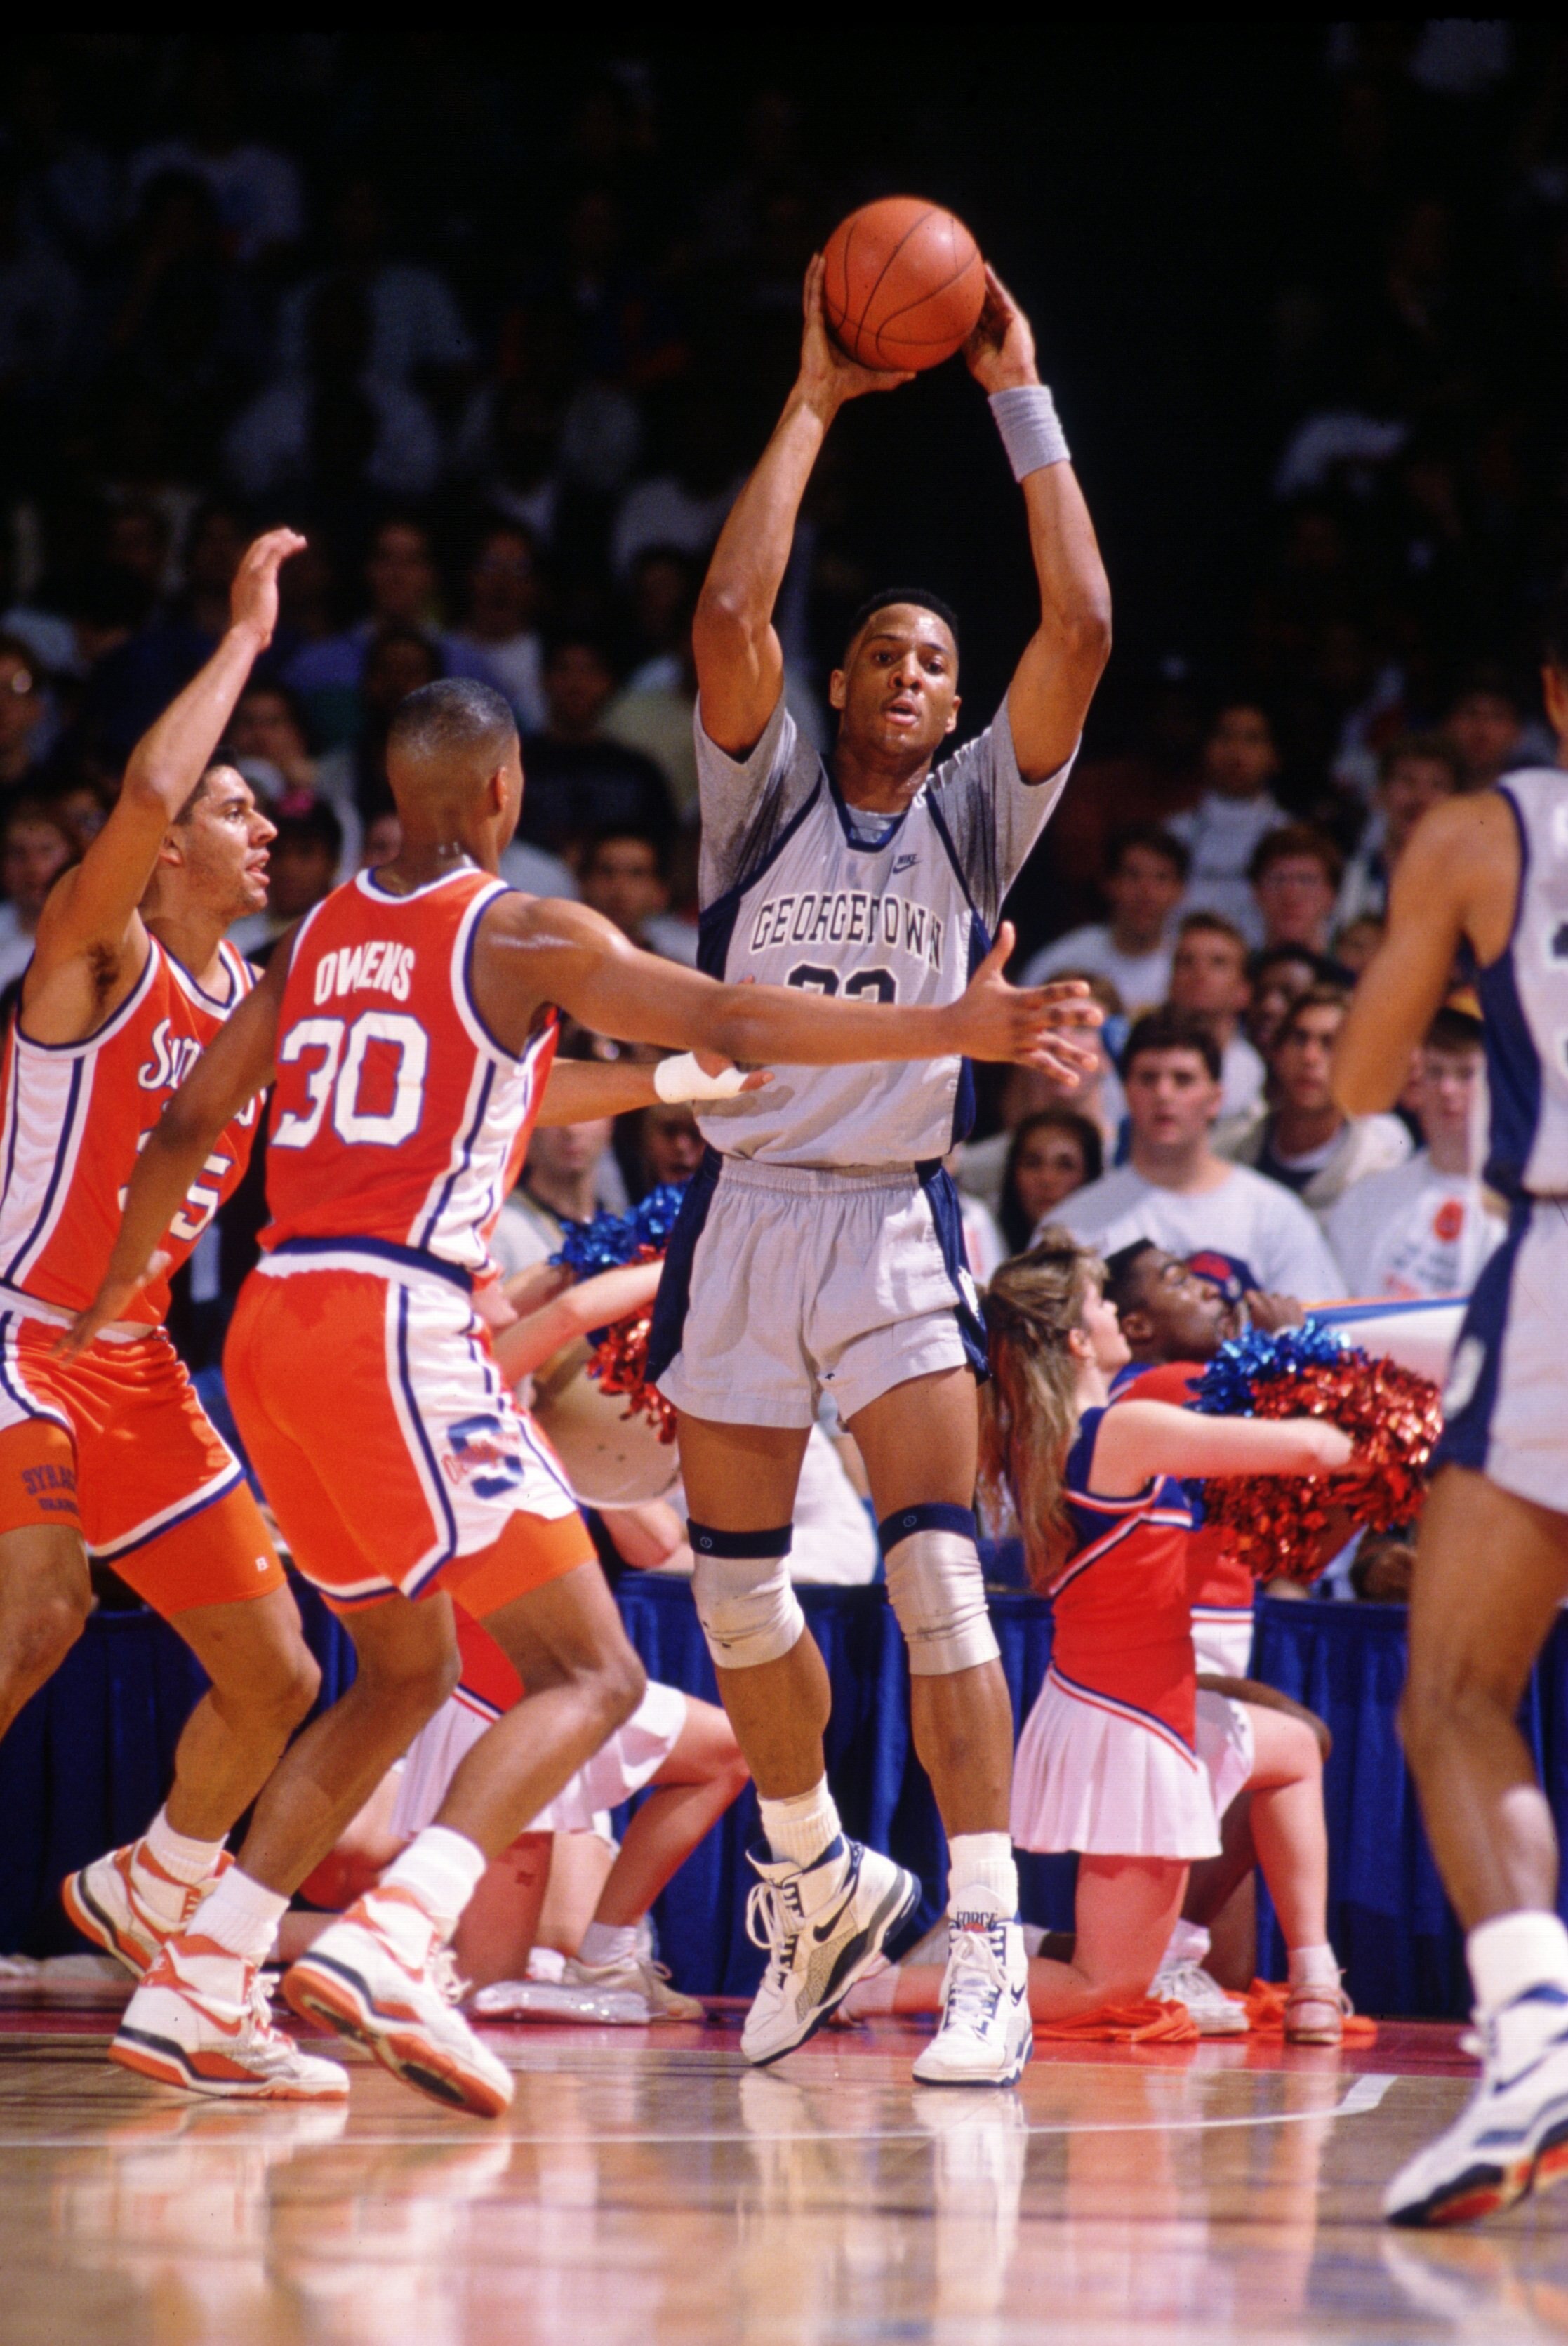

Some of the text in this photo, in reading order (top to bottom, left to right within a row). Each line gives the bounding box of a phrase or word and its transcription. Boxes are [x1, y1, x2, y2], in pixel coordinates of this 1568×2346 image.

[898, 854, 918, 864] NIKE
[313, 941, 416, 1007] OWENS
[750, 889, 945, 975] GEORGETOWN
[270, 1008, 430, 1150] 30
[117, 1125, 235, 1242] 5
